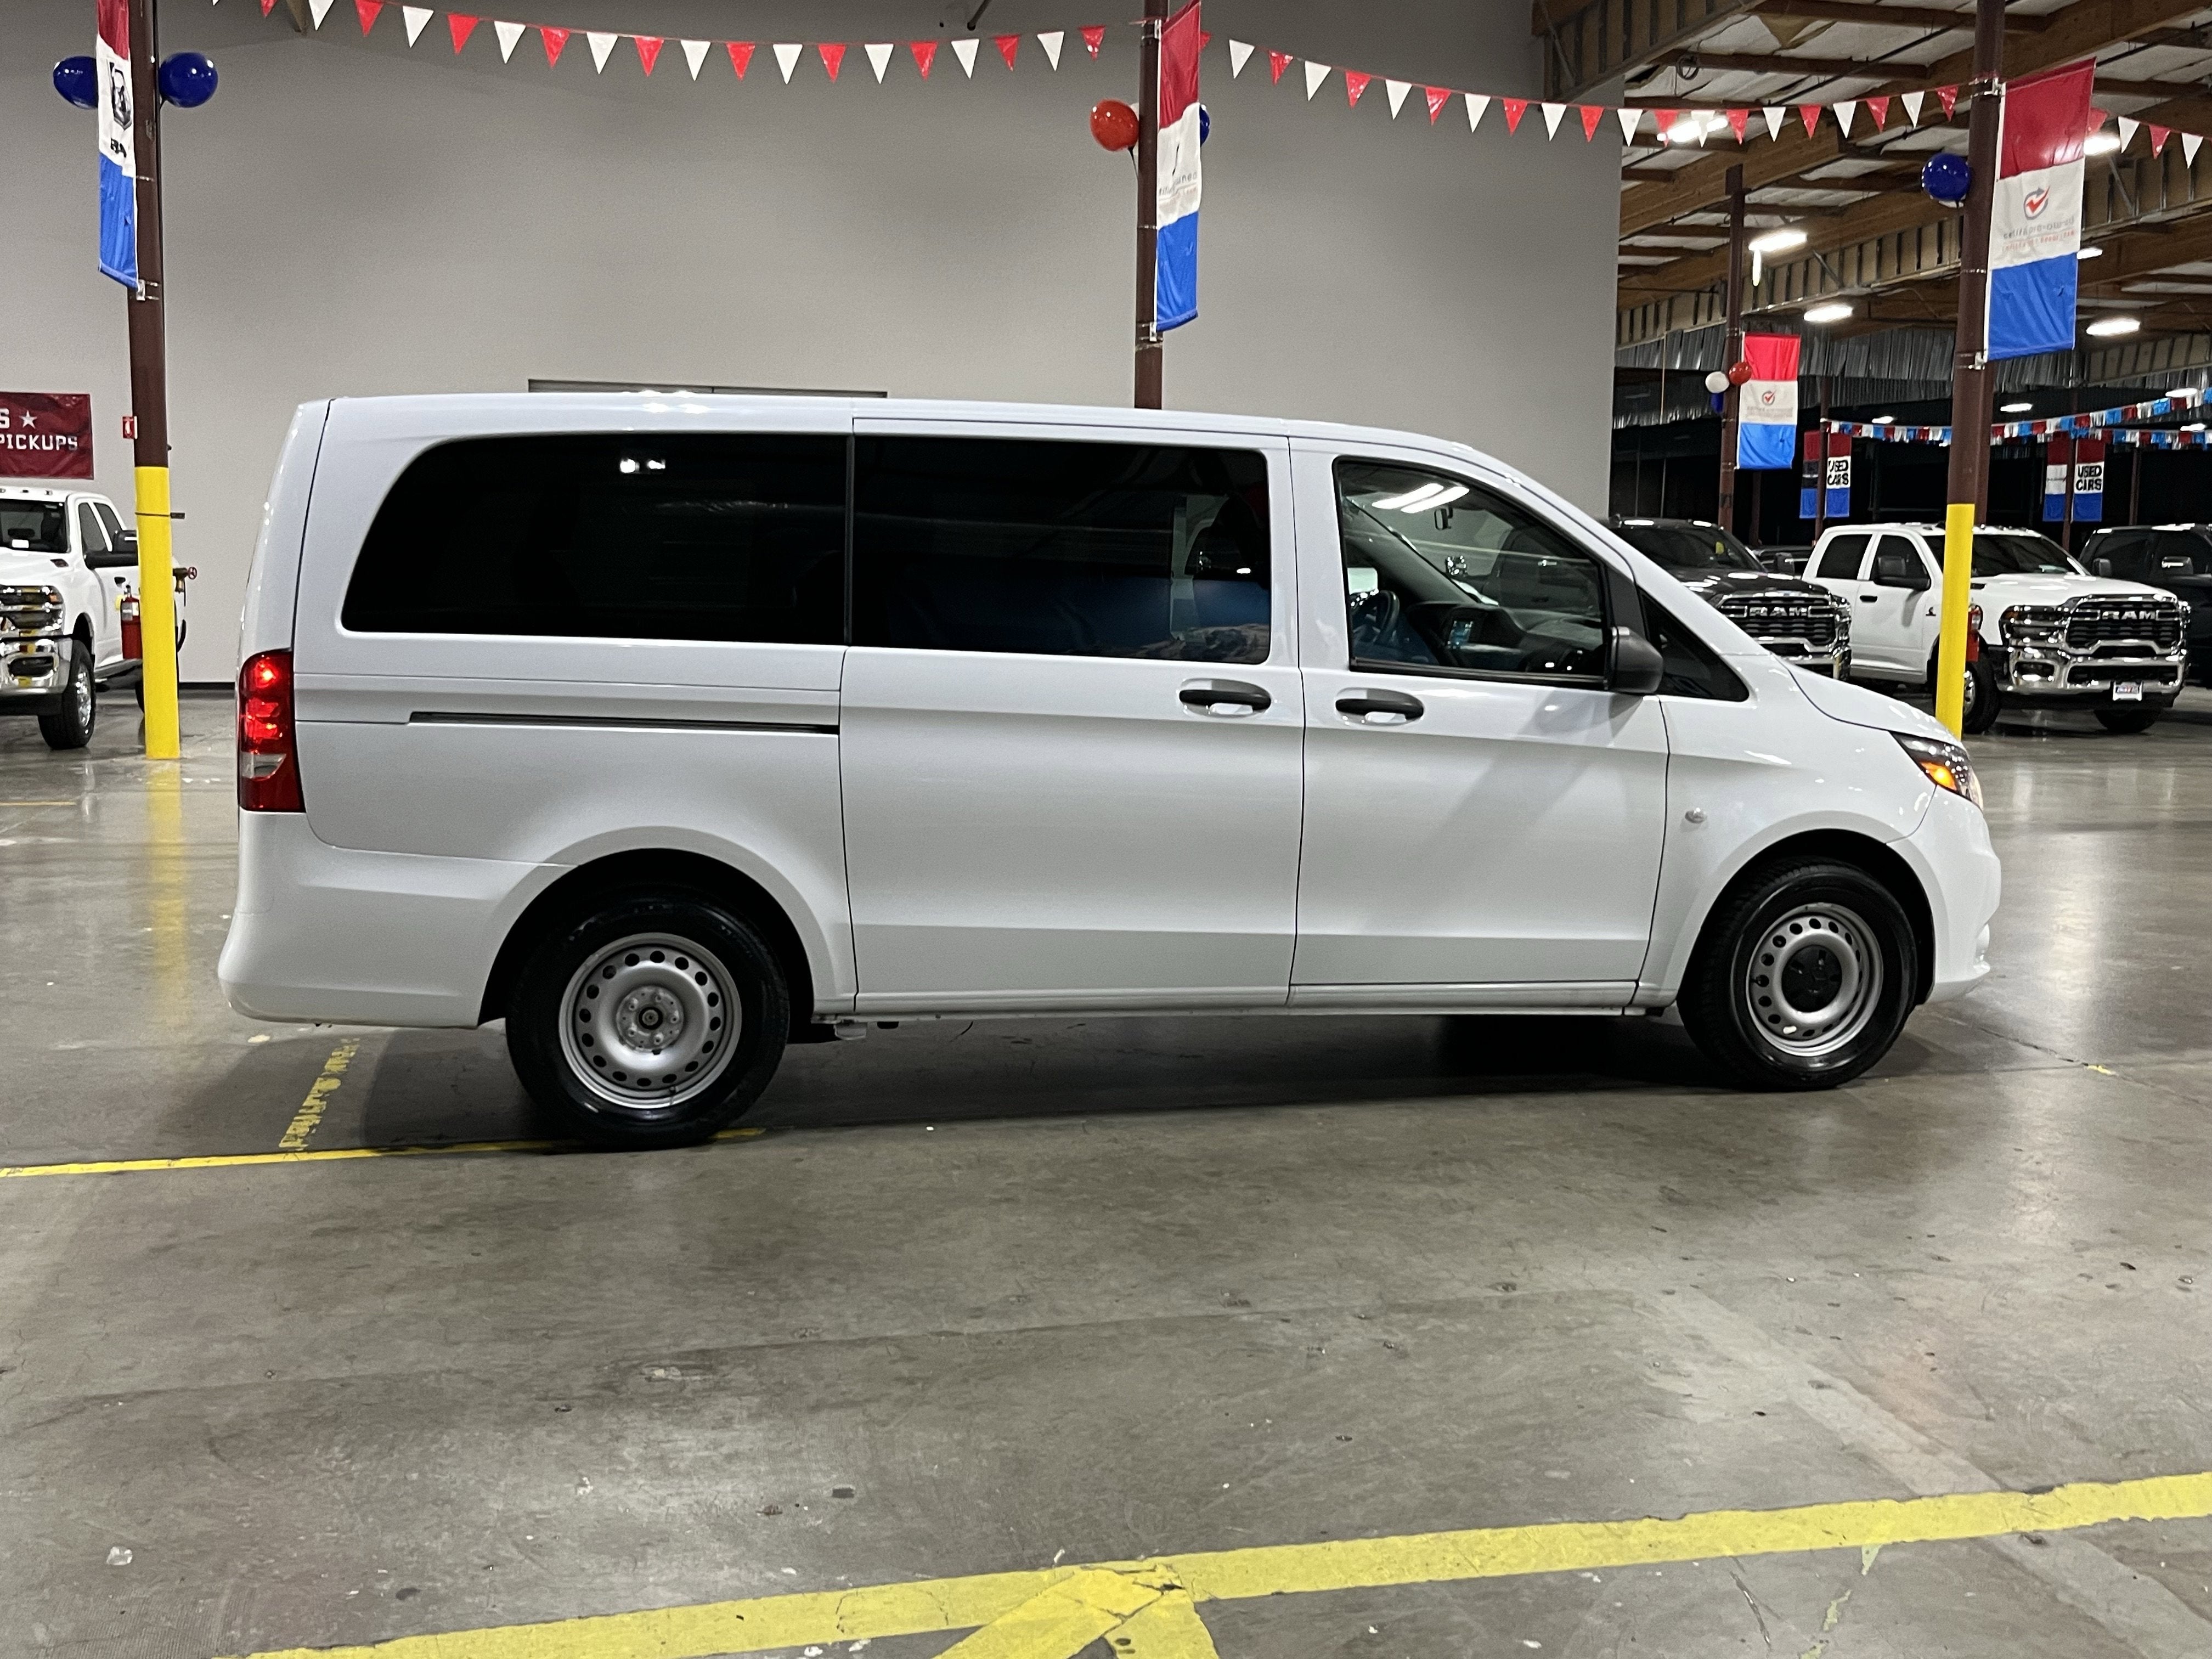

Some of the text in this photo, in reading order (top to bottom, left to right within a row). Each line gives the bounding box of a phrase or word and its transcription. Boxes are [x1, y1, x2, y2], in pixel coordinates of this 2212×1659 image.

[110, 137, 127, 158] RA
[1829, 460, 1849, 472] USED
[2078, 465, 2102, 478] USED
[2076, 478, 2102, 491] CARS
[1750, 607, 1807, 617] RAM
[2102, 610, 2155, 620] RAM
